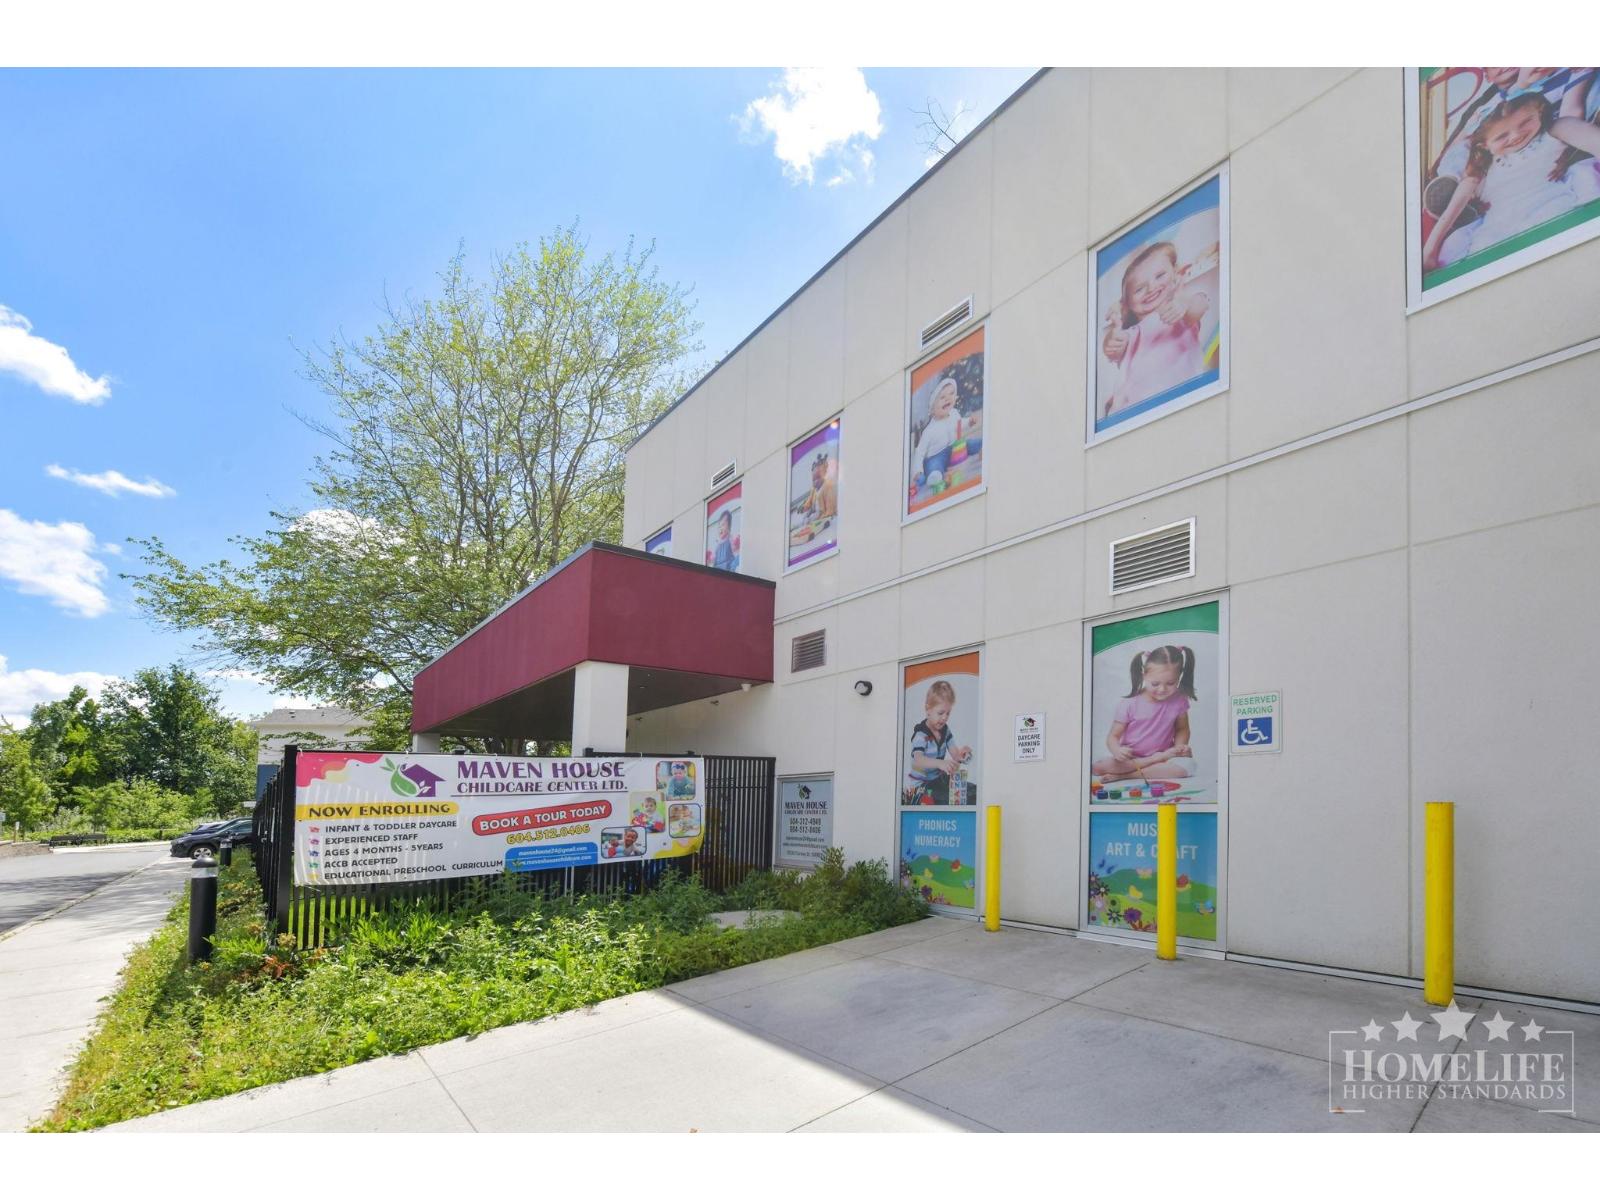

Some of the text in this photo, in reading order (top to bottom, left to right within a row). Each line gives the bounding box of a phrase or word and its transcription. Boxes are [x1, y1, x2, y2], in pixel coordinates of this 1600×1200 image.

[1233, 695, 1277, 706] RESERVED
[1237, 705, 1273, 716] PARKING
[457, 760, 625, 779] MAVEN HOUSE
[457, 780, 628, 793] CHILDCARE CENTER LTD.
[309, 803, 451, 817] NOW ENROLLING
[805, 801, 828, 810] HOUSE
[479, 805, 607, 831] BOOK A TOUR TODAY
[325, 820, 457, 833] INFANT & TODDLER DAYCARE
[918, 819, 957, 832] PHONICS
[1127, 822, 1158, 837] MUS
[325, 833, 419, 846] EXPERIENCED STAFF
[506, 823, 591, 845] 604.512.0406
[914, 835, 961, 849] NUMERACY
[324, 848, 350, 857] AGES
[352, 848, 359, 856] 4
[362, 845, 403, 855] MONTHS
[1106, 842, 1199, 860] ART & CFT
[324, 857, 398, 869] ACCB ACCEPTED
[324, 860, 503, 880] EDUCATIONAL PRESCHOOL CURRICULUM
